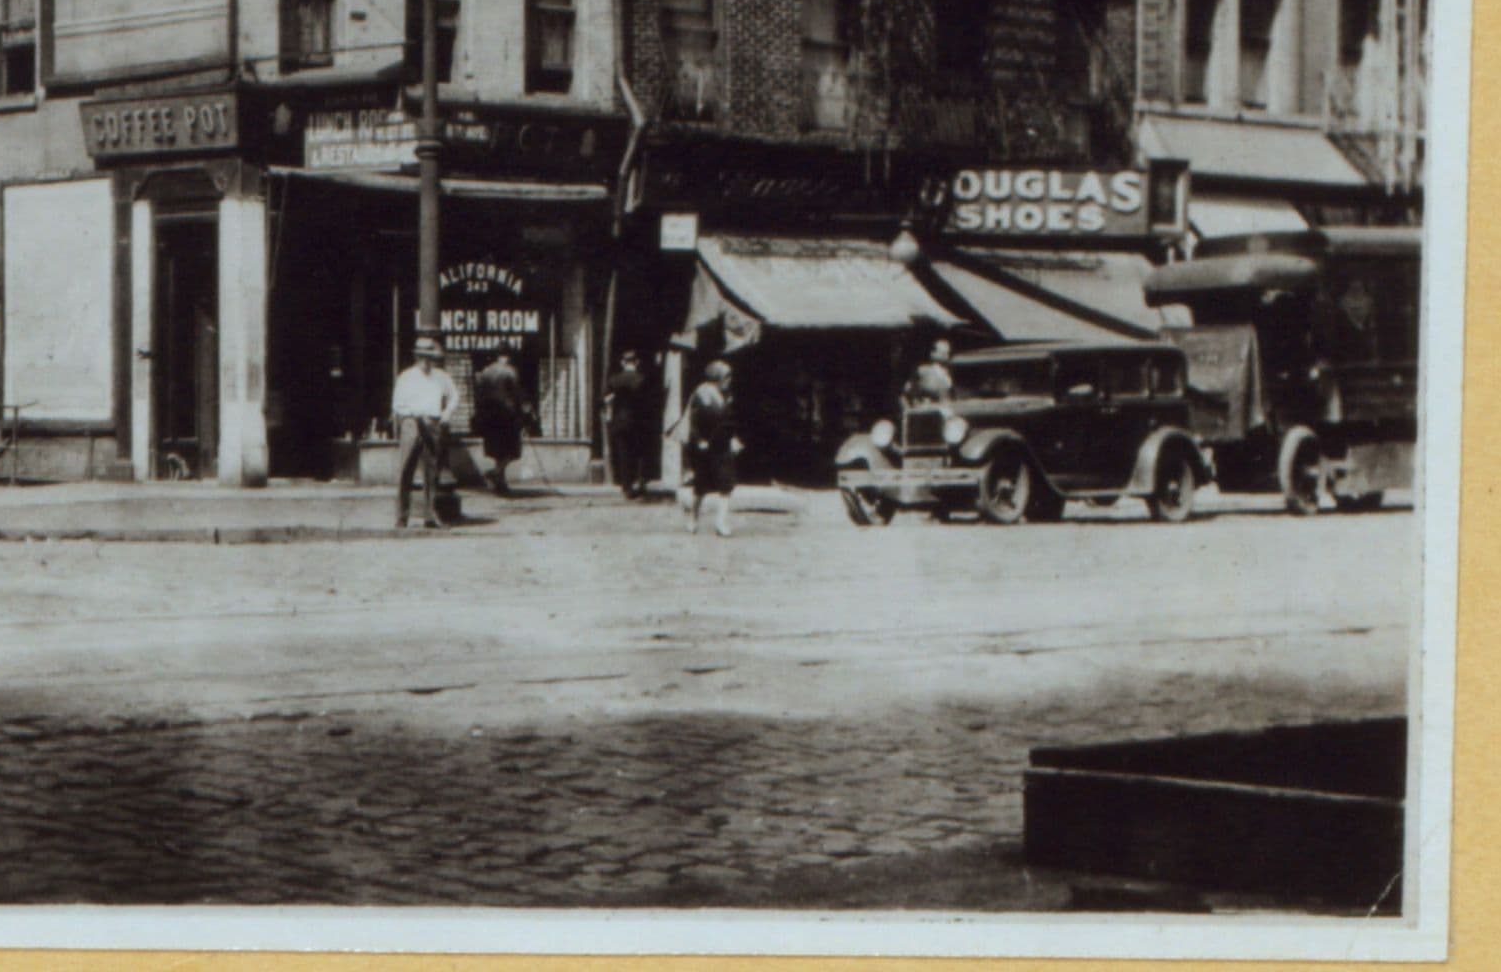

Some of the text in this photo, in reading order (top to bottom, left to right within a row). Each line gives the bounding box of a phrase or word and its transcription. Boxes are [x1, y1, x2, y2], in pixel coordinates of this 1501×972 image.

[92, 102, 230, 150] COFFEE POT
[308, 112, 352, 141] LUNCH
[955, 202, 1106, 232] SHOES
[439, 261, 524, 296] ALIFORNIA
[486, 309, 539, 333] ROOM
